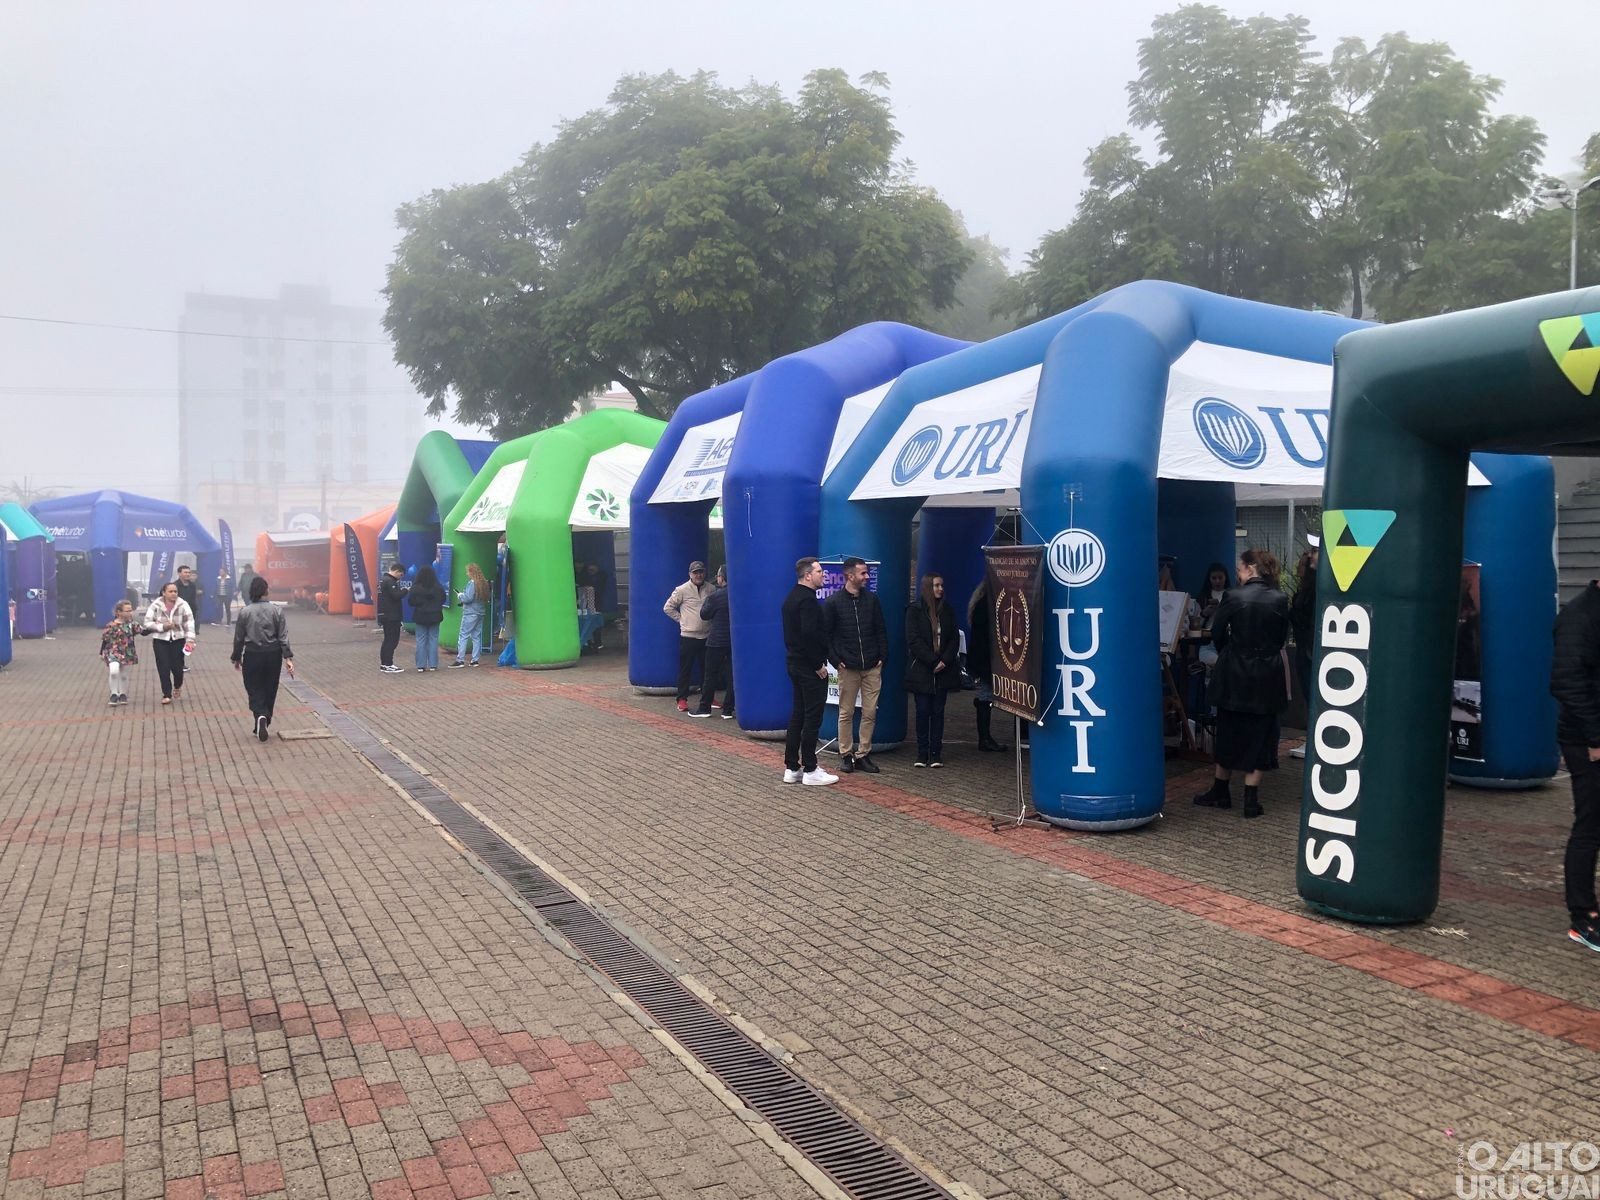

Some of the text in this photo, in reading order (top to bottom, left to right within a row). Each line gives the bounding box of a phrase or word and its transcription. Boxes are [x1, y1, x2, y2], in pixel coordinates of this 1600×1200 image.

[933, 408, 1029, 480] URI
[1257, 406, 1329, 469] U
[992, 673, 1038, 710] DIREITO
[1052, 607, 1107, 773] URI
[1305, 604, 1371, 883] SICOOB
